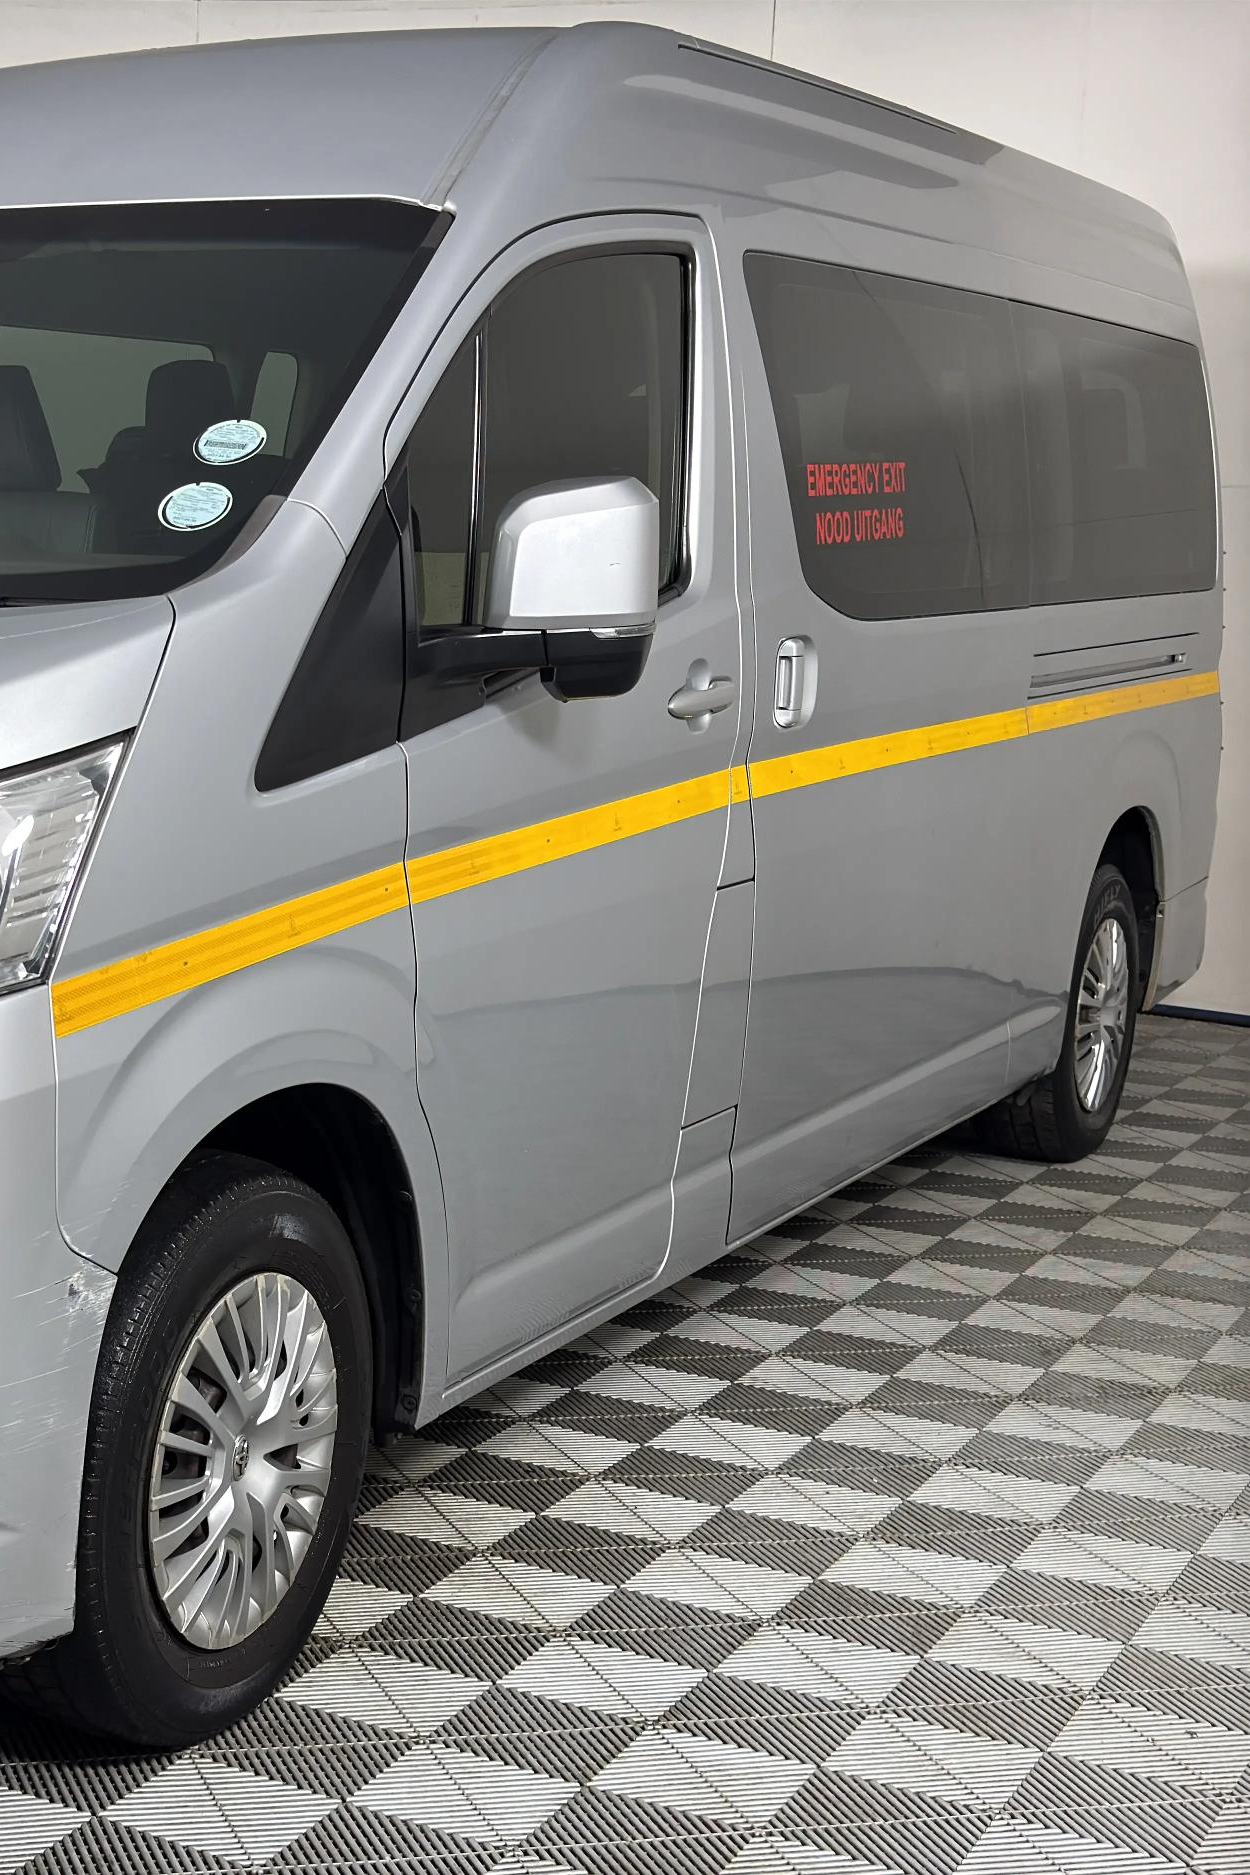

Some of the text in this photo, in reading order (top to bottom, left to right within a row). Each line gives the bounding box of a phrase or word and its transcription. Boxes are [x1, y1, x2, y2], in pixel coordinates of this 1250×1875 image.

[806, 462, 906, 496] EMERGENCY EXIT
[816, 507, 904, 544] NOOD UITGANG
